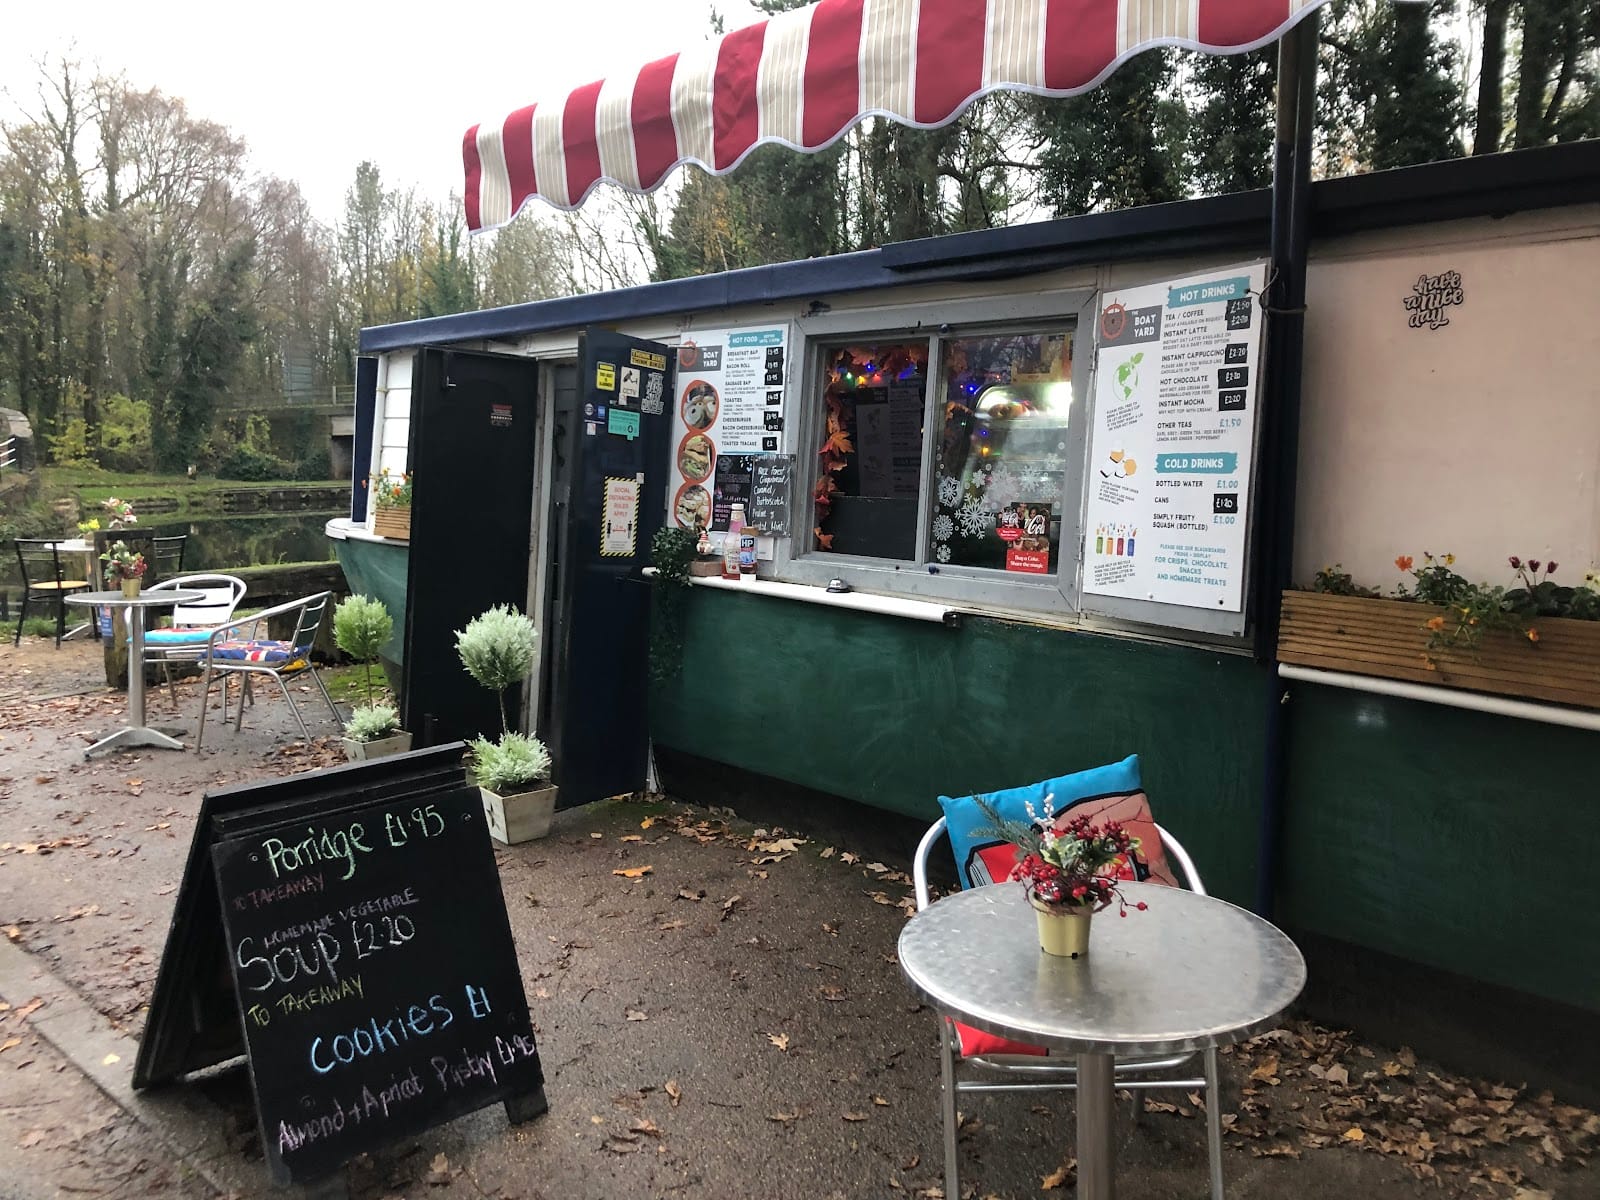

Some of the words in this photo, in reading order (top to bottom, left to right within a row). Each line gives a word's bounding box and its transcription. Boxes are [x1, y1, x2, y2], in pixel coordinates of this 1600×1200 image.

[1413, 270, 1462, 294] have
[1180, 290, 1199, 302] HOT
[1202, 284, 1235, 299] DRINKS
[1403, 295, 1422, 310] a
[1419, 288, 1464, 312] nice
[1134, 314, 1156, 326] BOAT
[1166, 314, 1175, 323] TEA
[1182, 309, 1204, 318] COFFEE
[1408, 309, 1450, 331] day
[1134, 328, 1155, 338] YARD
[1163, 329, 1187, 338] INSTANT
[1189, 326, 1208, 335] LATTE
[703, 351, 718, 359] BOAT
[1161, 353, 1185, 361] INSTANT
[1187, 349, 1225, 358] CAPPUCCINO
[1160, 378, 1172, 386] HOT
[1173, 375, 1208, 384] CHOCOLATE
[1158, 400, 1182, 408] INSTANT
[1183, 398, 1205, 406] MOCHA
[1157, 421, 1176, 429] OTHER
[1178, 420, 1193, 428] TEAS
[1219, 418, 1242, 428] £1.50
[1164, 459, 1188, 469] COLD
[1191, 458, 1224, 469] DRINKS
[1155, 480, 1181, 488] BOTTLED
[1182, 480, 1204, 488] WATER
[1216, 479, 1239, 490] £1.00
[1154, 496, 1170, 504] CANS
[1152, 513, 1174, 521] SIMPLY
[1175, 513, 1195, 522] FRUITY
[1213, 515, 1235, 525] £1.00
[1152, 520, 1175, 529] SQUASH
[1176, 522, 1209, 531] (BOTTLED)
[741, 539, 754, 547] HP
[1179, 566, 1202, 574] SNACKS
[1170, 574, 1202, 584] HOMEMADE
[1203, 577, 1226, 586] TREATS
[262, 822, 374, 881] Porridge
[247, 872, 325, 909] TAKEAWAY
[263, 913, 336, 947] HOMEMADE
[338, 887, 420, 922] VEGETABLE
[276, 974, 366, 1016] TAKEAWAY
[464, 984, 492, 1018] £1
[278, 1096, 346, 1155] Almond
[361, 1066, 425, 1117] Apricot
[430, 1046, 499, 1091] Pastry
